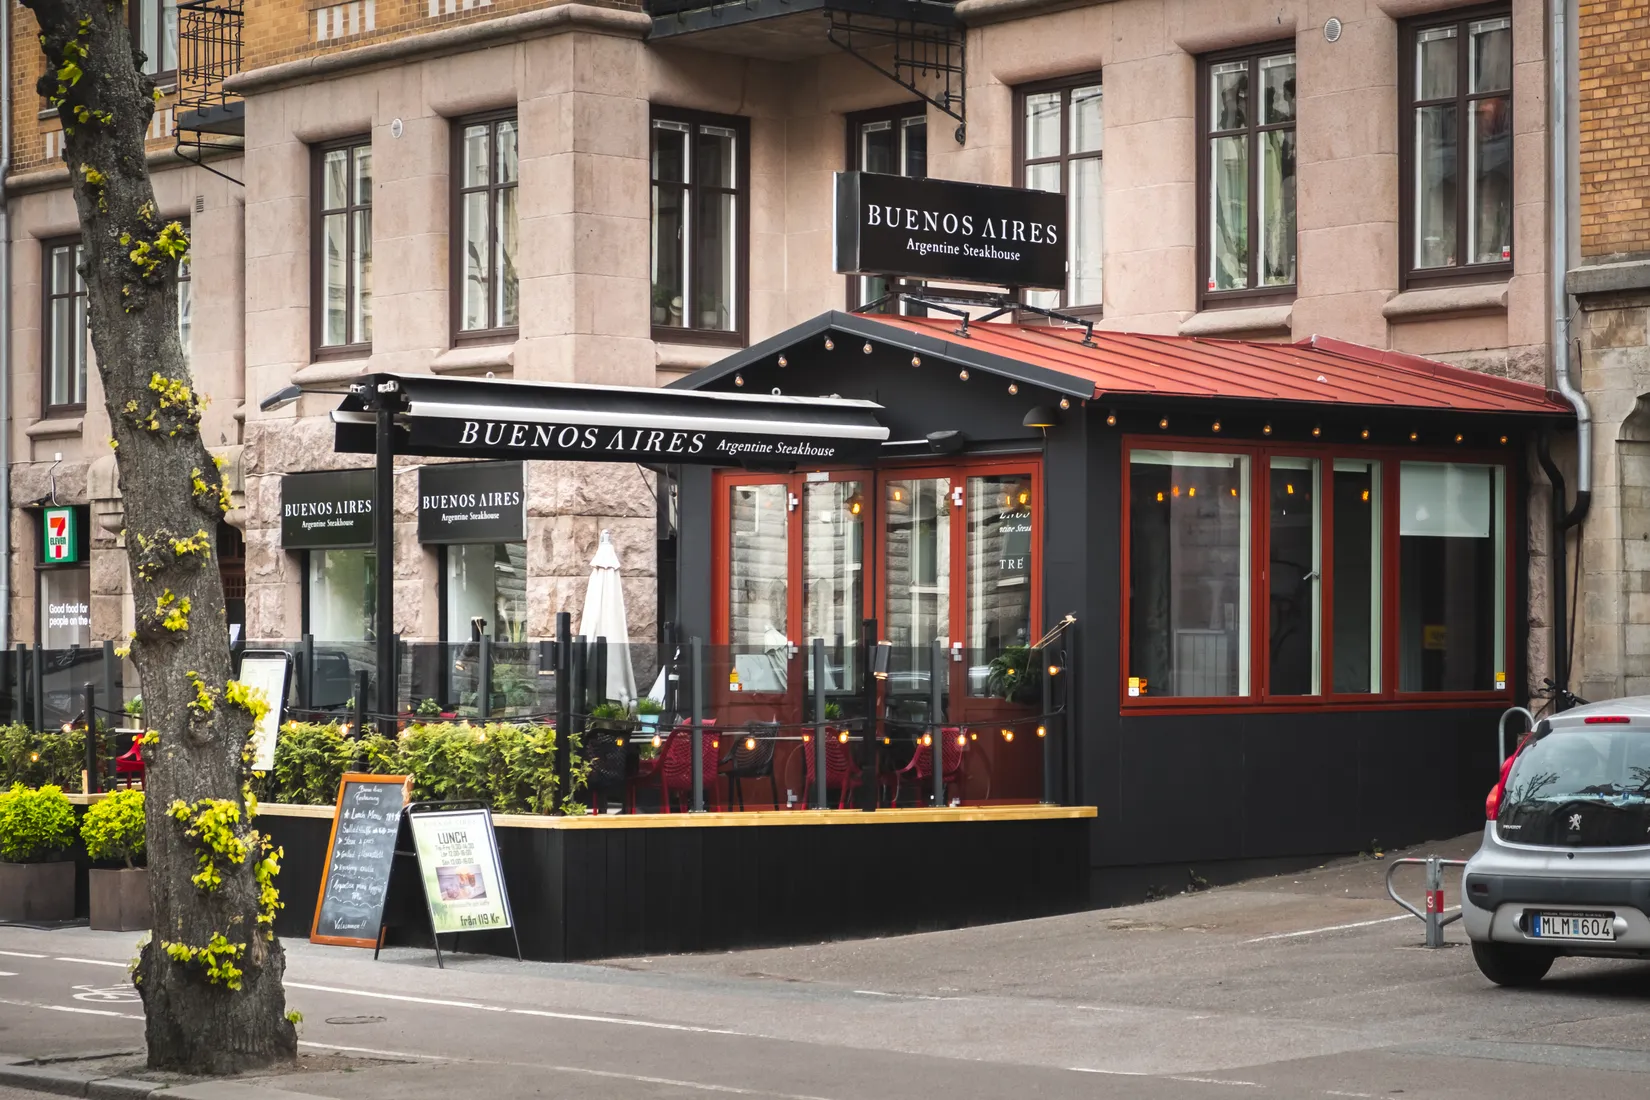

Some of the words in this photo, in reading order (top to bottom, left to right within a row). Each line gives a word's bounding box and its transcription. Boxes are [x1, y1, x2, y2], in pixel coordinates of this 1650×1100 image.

[867, 204, 974, 236] BUENOS
[981, 217, 1058, 245] AIRES
[906, 238, 960, 256] Argentine
[963, 244, 1021, 261] Steakhouse
[459, 421, 599, 449] BUENOS
[605, 428, 706, 454] AIRES
[716, 438, 773, 455] Argentine
[775, 441, 835, 457] Steakhouse
[285, 501, 333, 517] BUENOS
[335, 499, 372, 514] AIRES
[422, 493, 476, 510] BUENOS
[478, 491, 520, 507] AIRES
[302, 519, 326, 530] Argentine
[327, 518, 354, 527] Steakhouse
[441, 512, 468, 524] Argentine
[469, 511, 499, 520] Steakhouse
[49, 603, 65, 614] Good
[65, 602, 79, 613] food
[79, 603, 88, 613] for
[49, 615, 69, 628] people
[69, 617, 77, 626] on
[78, 614, 88, 626] the
[437, 831, 468, 844] LUNCH
[460, 914, 477, 926] från
[477, 913, 489, 925] 119
[489, 913, 500, 924] Kr
[1542, 917, 1570, 936] MLM
[1581, 919, 1610, 936] 604
